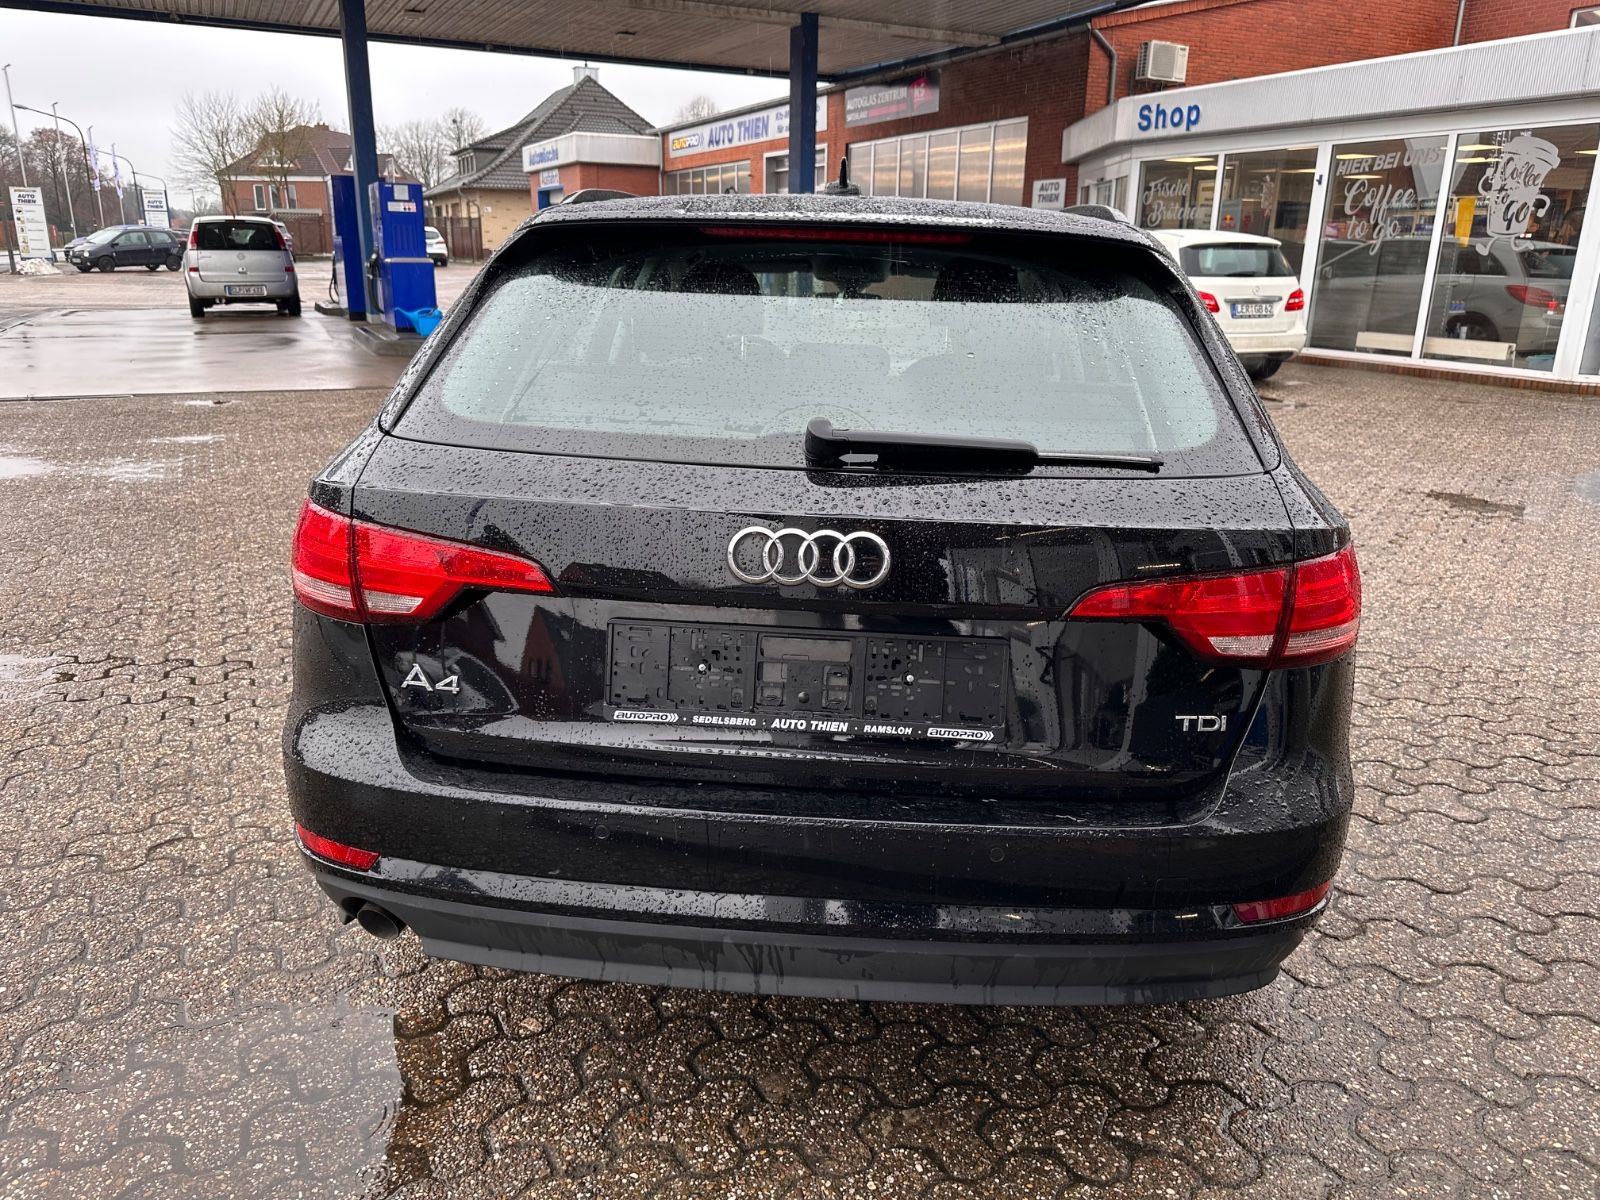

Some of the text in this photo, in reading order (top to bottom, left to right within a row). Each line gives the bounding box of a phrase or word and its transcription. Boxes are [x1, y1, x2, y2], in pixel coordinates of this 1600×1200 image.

[847, 93, 877, 110] AUTOGLAS
[878, 86, 907, 104] ZENTRUM
[708, 123, 734, 148] AUTO
[737, 115, 770, 142] THIEN
[1137, 103, 1201, 132] Shop
[1336, 147, 1440, 176] HIER BEI UNS
[1037, 193, 1060, 204] THIEN
[1039, 182, 1060, 192] AUTO
[1143, 176, 1189, 205] Frische
[1344, 179, 1416, 225] Coffee
[1347, 216, 1401, 256] to go
[1236, 304, 1250, 314] LER
[1264, 304, 1273, 314] 62
[401, 663, 460, 694] A4
[692, 715, 757, 726] SEDELSBERG
[771, 718, 807, 730] AUTO
[810, 719, 849, 732] THIEN
[863, 725, 913, 735] RAMSLOH
[1175, 715, 1227, 732] TDI
